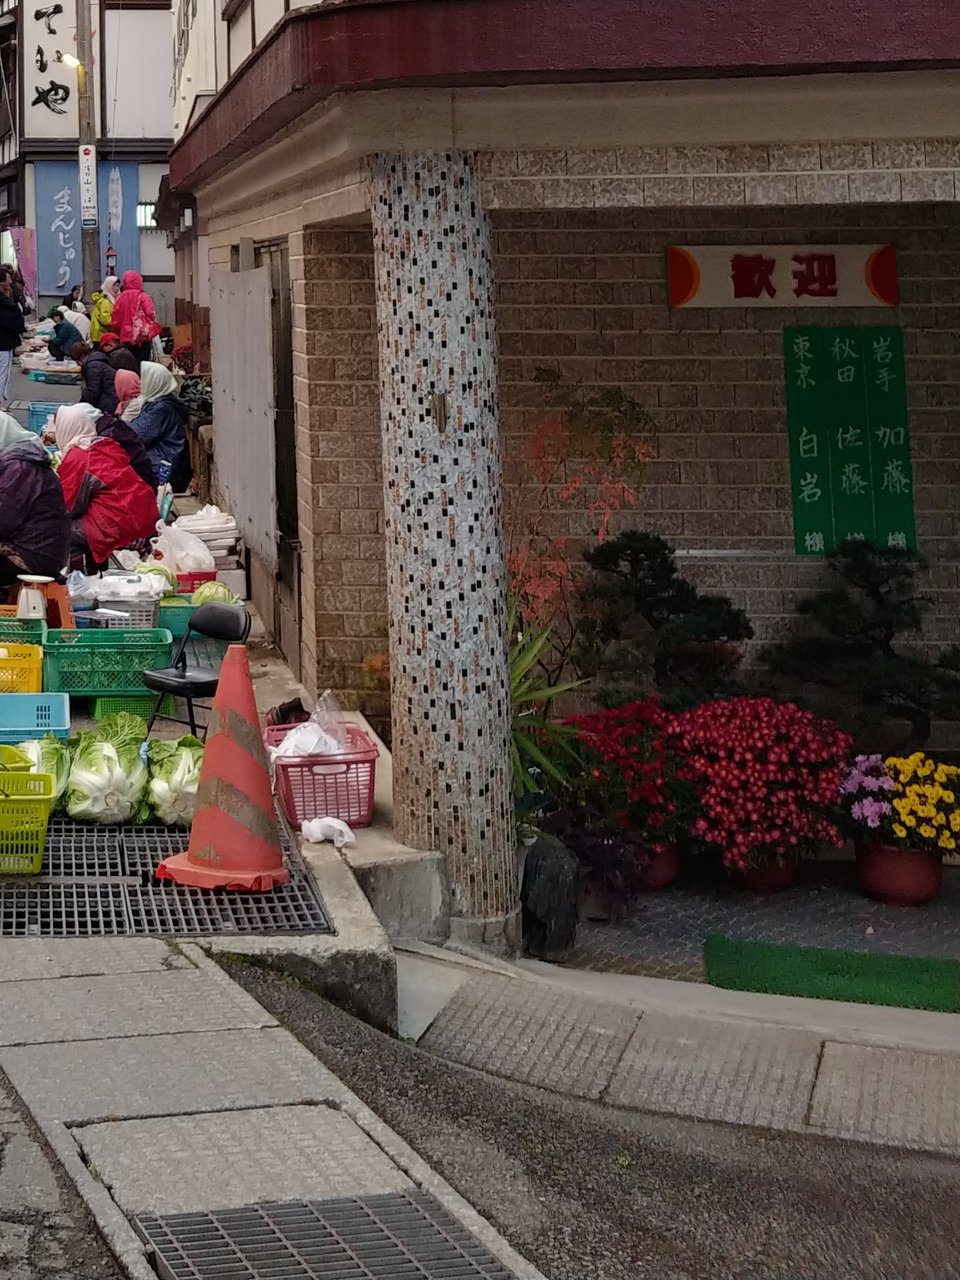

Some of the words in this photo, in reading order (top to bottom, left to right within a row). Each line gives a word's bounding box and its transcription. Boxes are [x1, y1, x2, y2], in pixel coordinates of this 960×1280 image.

[51, 186, 76, 288] まんじゅう
[730, 254, 838, 299] 歓迎
[793, 335, 816, 389] 東京
[830, 336, 860, 383] 秋田
[873, 336, 897, 392] 岩手
[798, 426, 822, 503] 白岩
[836, 425, 868, 496] 佐藤
[875, 425, 911, 495] 加藤
[804, 531, 825, 553] 様
